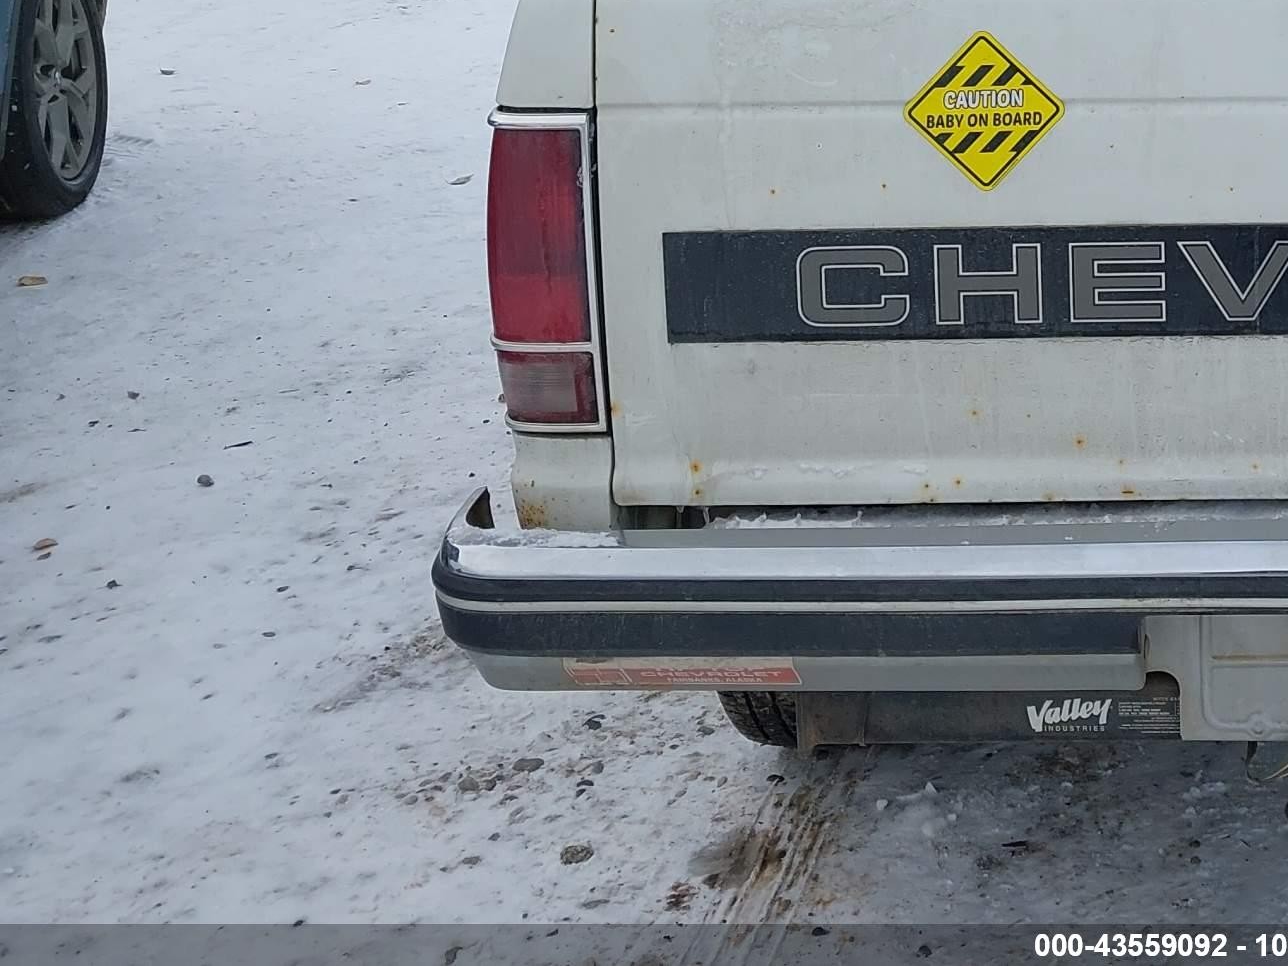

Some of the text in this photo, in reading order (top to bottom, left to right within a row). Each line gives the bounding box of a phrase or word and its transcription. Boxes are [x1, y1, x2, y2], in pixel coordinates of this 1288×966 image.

[943, 88, 1024, 109] CAUTION
[926, 111, 1043, 129] BABY ON BOARD
[639, 670, 782, 678] CHEVROLET
[1026, 697, 1113, 733] Valley
[1044, 724, 1106, 733] INDUSTRIES
